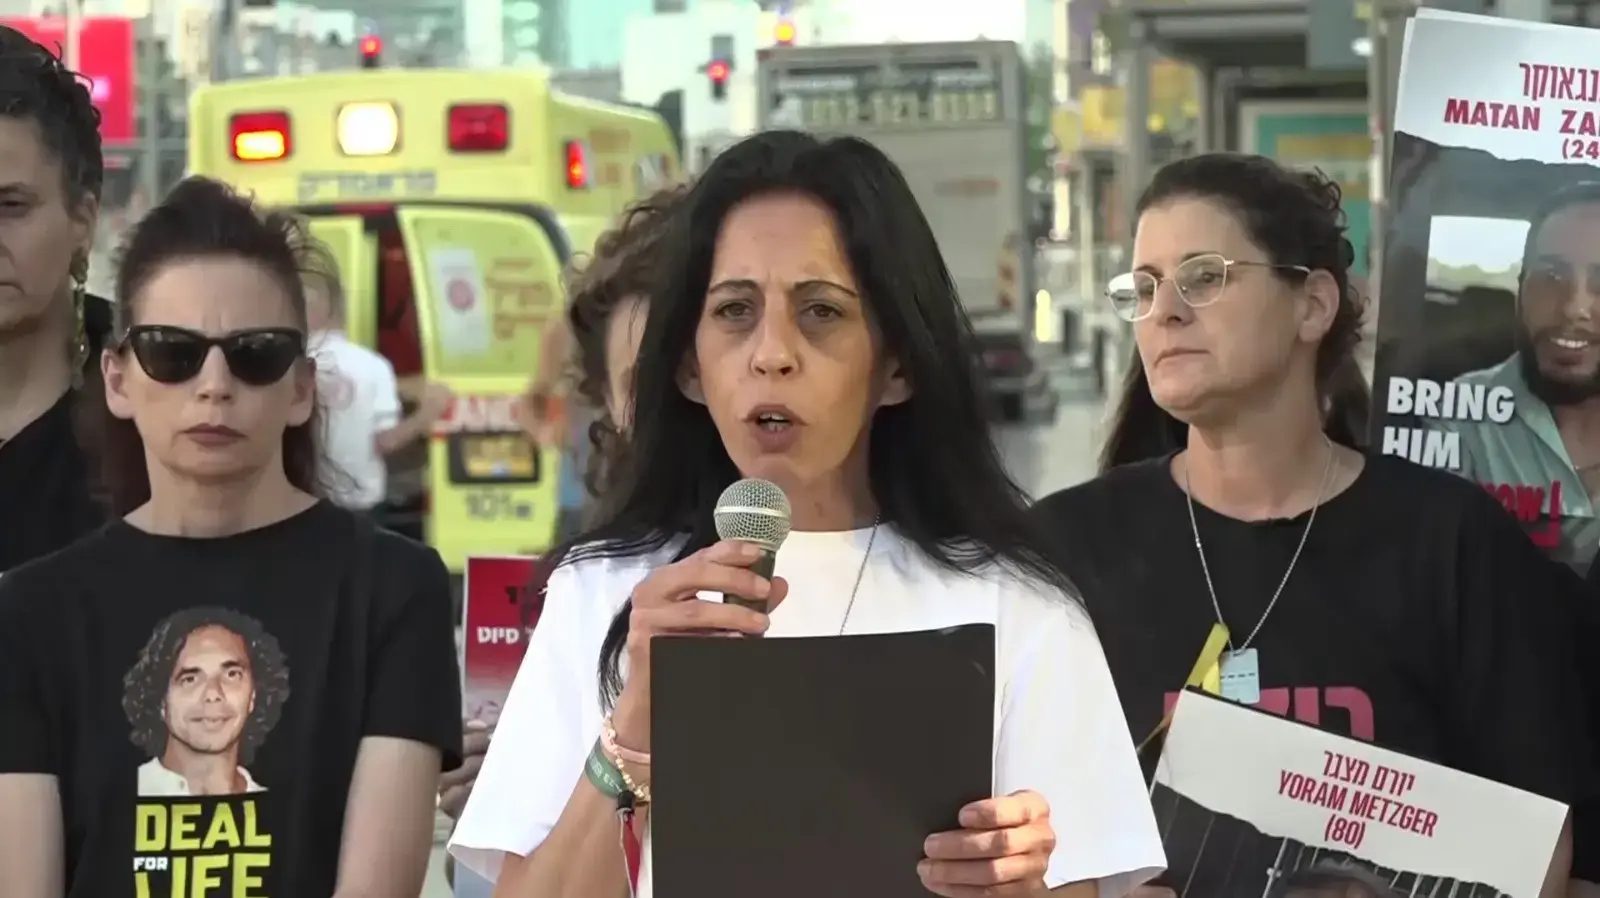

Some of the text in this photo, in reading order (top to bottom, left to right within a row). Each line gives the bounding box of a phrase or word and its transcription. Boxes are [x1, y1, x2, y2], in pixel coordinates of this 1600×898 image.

[1519, 62, 1600, 102] נגאוקר
[1444, 98, 1600, 136] MATAN ZA
[1387, 376, 1515, 423] BRING
[1382, 426, 1460, 469] HIM
[1322, 750, 1416, 797] יורם מצגר
[1278, 769, 1439, 838] YORAM METZGER
[135, 801, 272, 852] DEAL
[1324, 814, 1366, 849] (80)
[133, 857, 168, 871] FOR
[135, 853, 271, 898] LIFE
